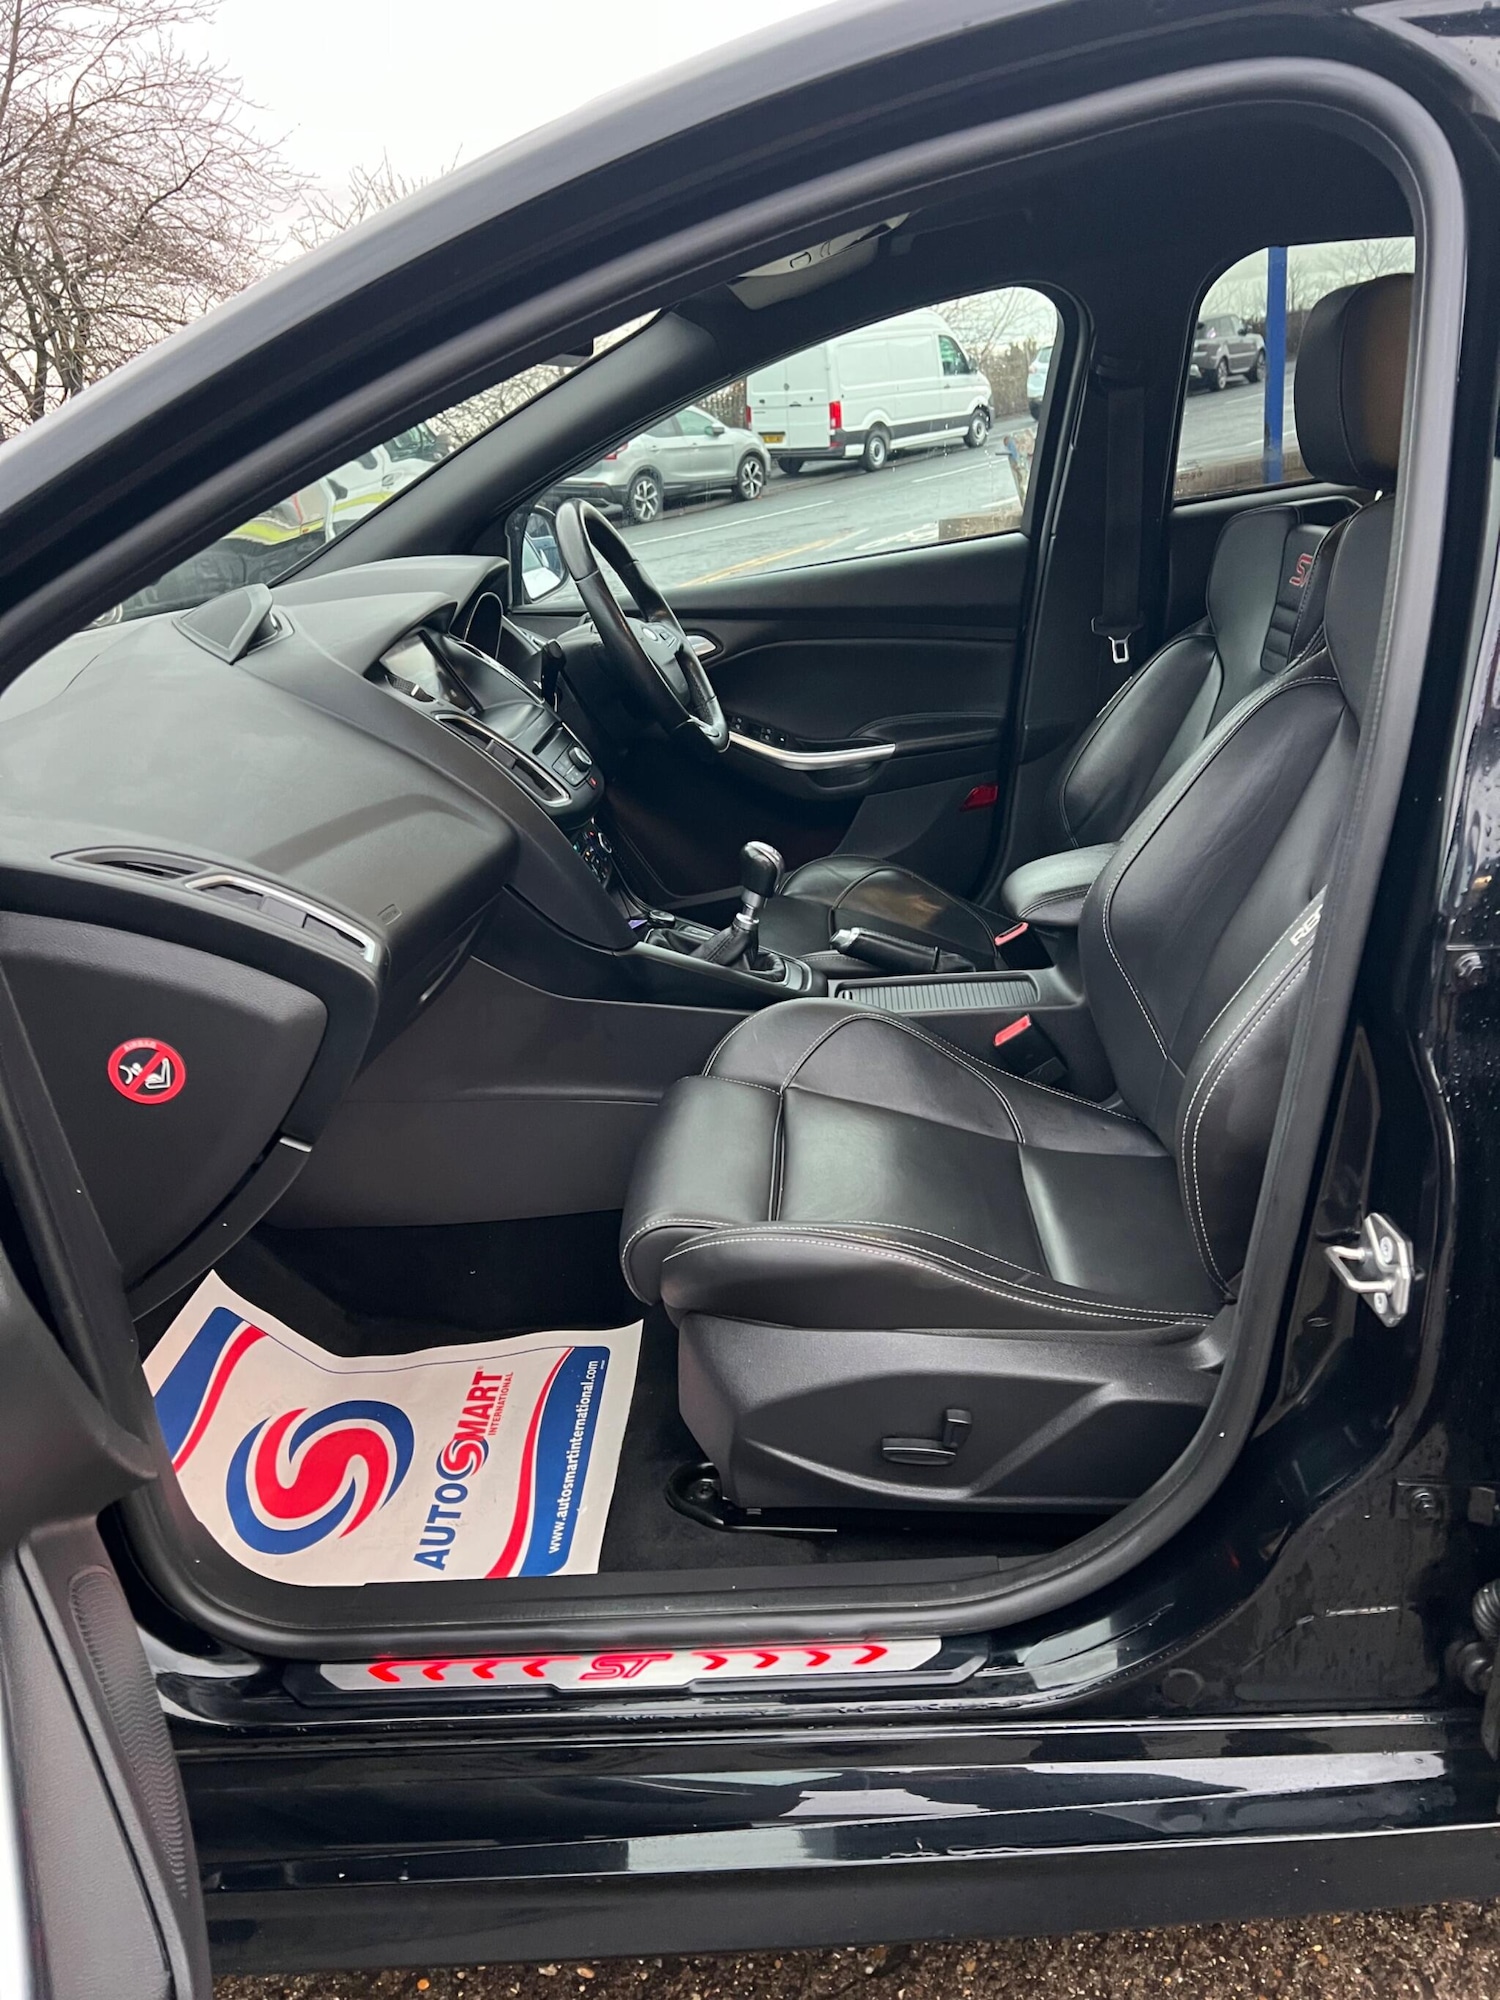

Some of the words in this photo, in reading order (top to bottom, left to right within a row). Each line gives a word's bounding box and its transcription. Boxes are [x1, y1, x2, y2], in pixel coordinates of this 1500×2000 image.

[488, 1372, 514, 1436] INTERNATIONAL
[549, 1360, 599, 1554] www.autosmartinternational.com
[579, 1653, 674, 1681] ST
